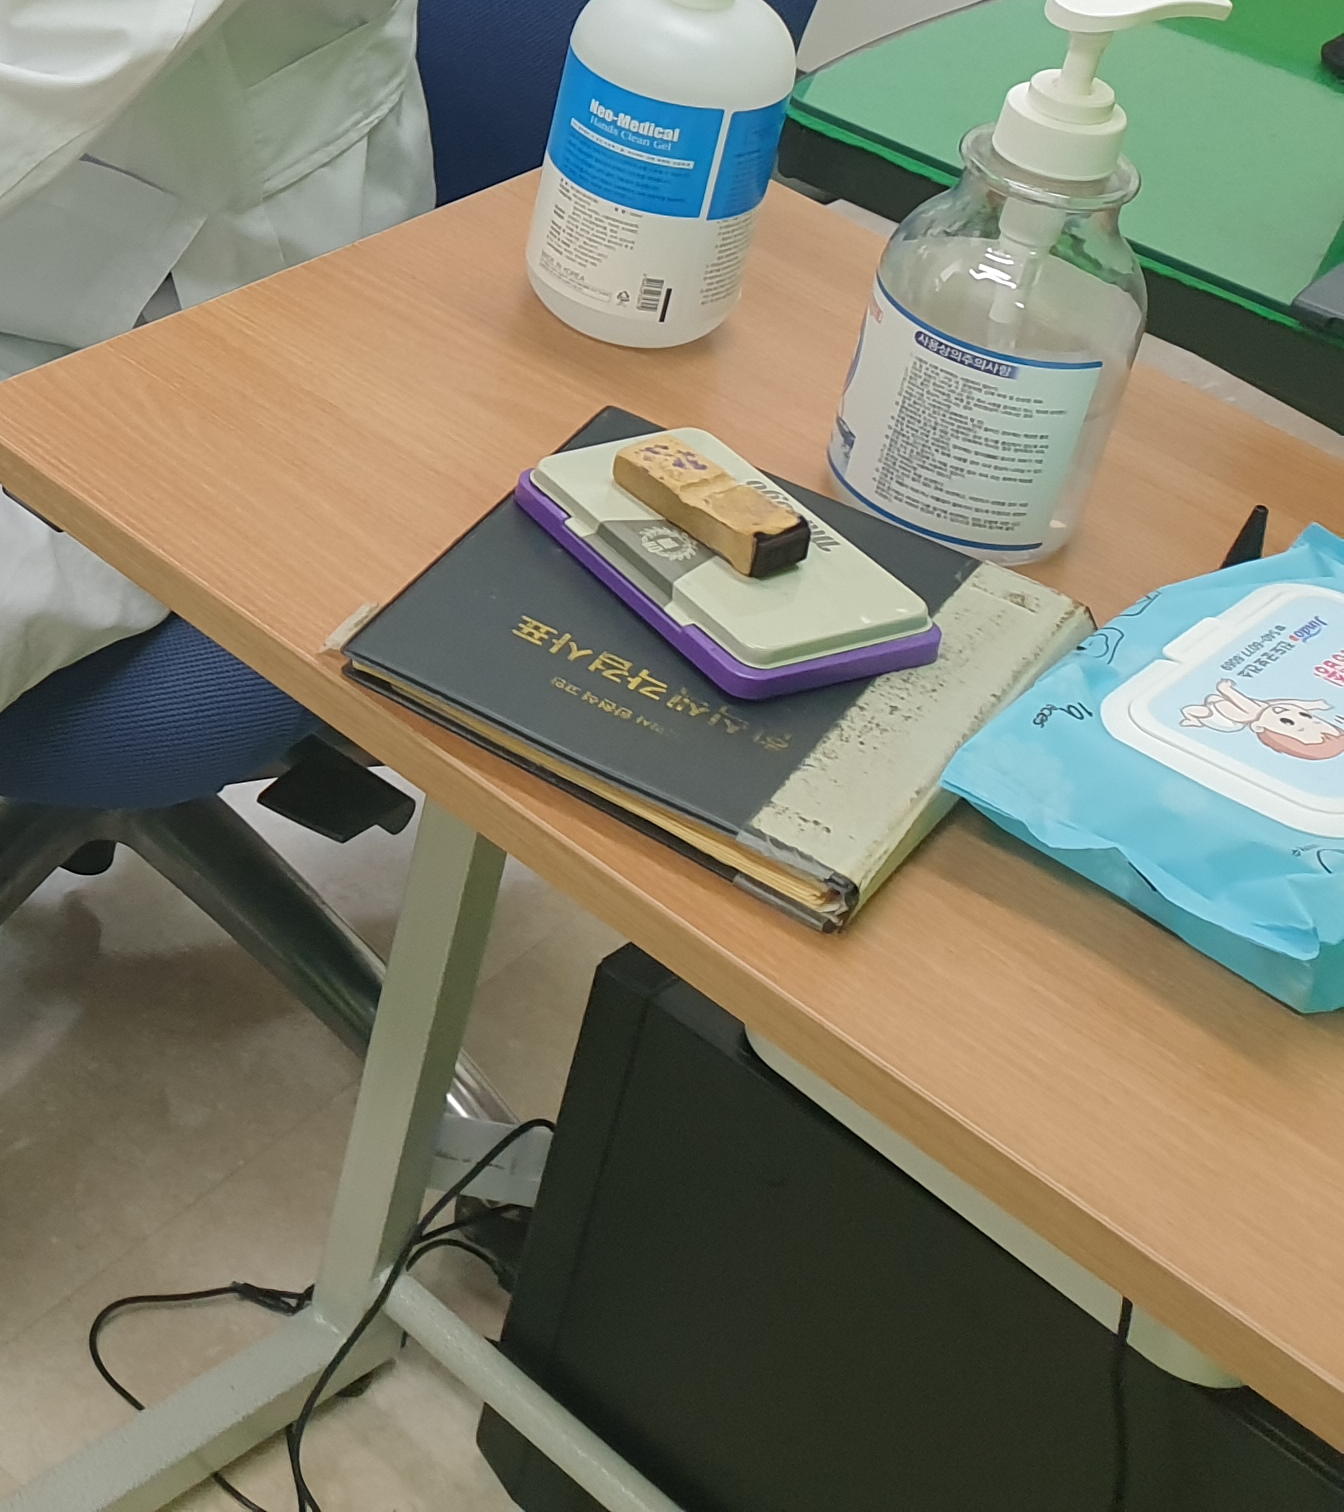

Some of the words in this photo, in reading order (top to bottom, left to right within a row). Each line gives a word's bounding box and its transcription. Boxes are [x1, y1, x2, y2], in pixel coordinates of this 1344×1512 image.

[590, 98, 680, 142] Neo-Medical
[590, 115, 618, 136] Hands
[620, 130, 650, 146] Clean
[653, 140, 672, 150] Gel
[918, 333, 1012, 376] 사용상의주의사항
